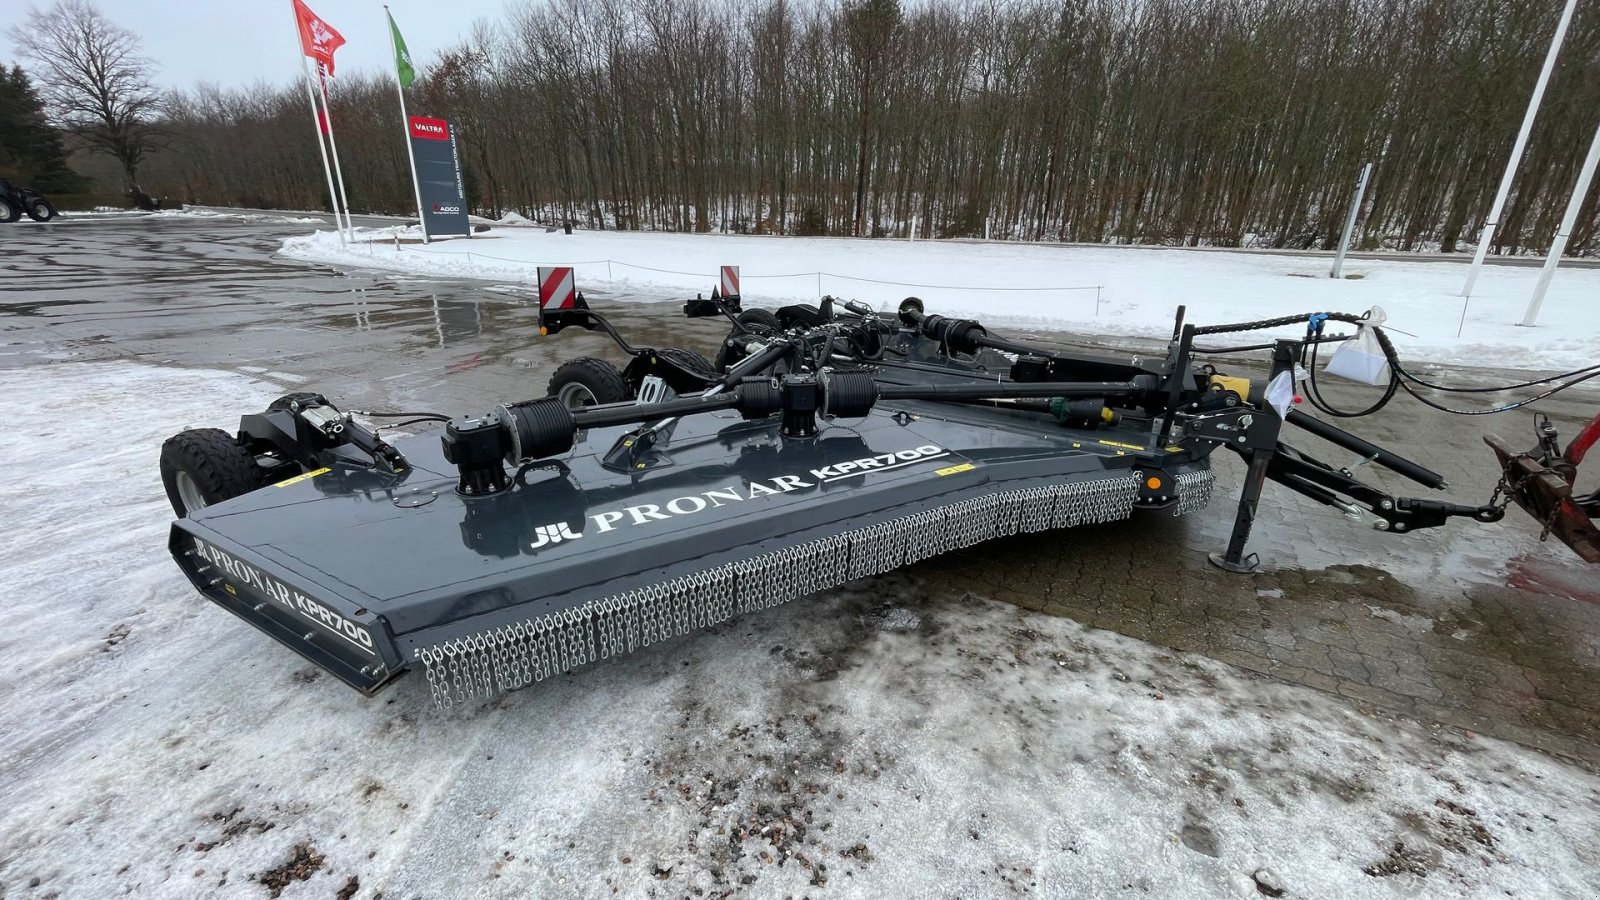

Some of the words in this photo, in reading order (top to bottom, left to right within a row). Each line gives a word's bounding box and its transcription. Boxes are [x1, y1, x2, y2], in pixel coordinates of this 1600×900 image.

[415, 123, 443, 133] VALTRA
[588, 474, 815, 534] PRONAR
[808, 444, 942, 480] KPR700
[209, 545, 296, 610] PRONAR
[293, 591, 373, 648] KPR700
